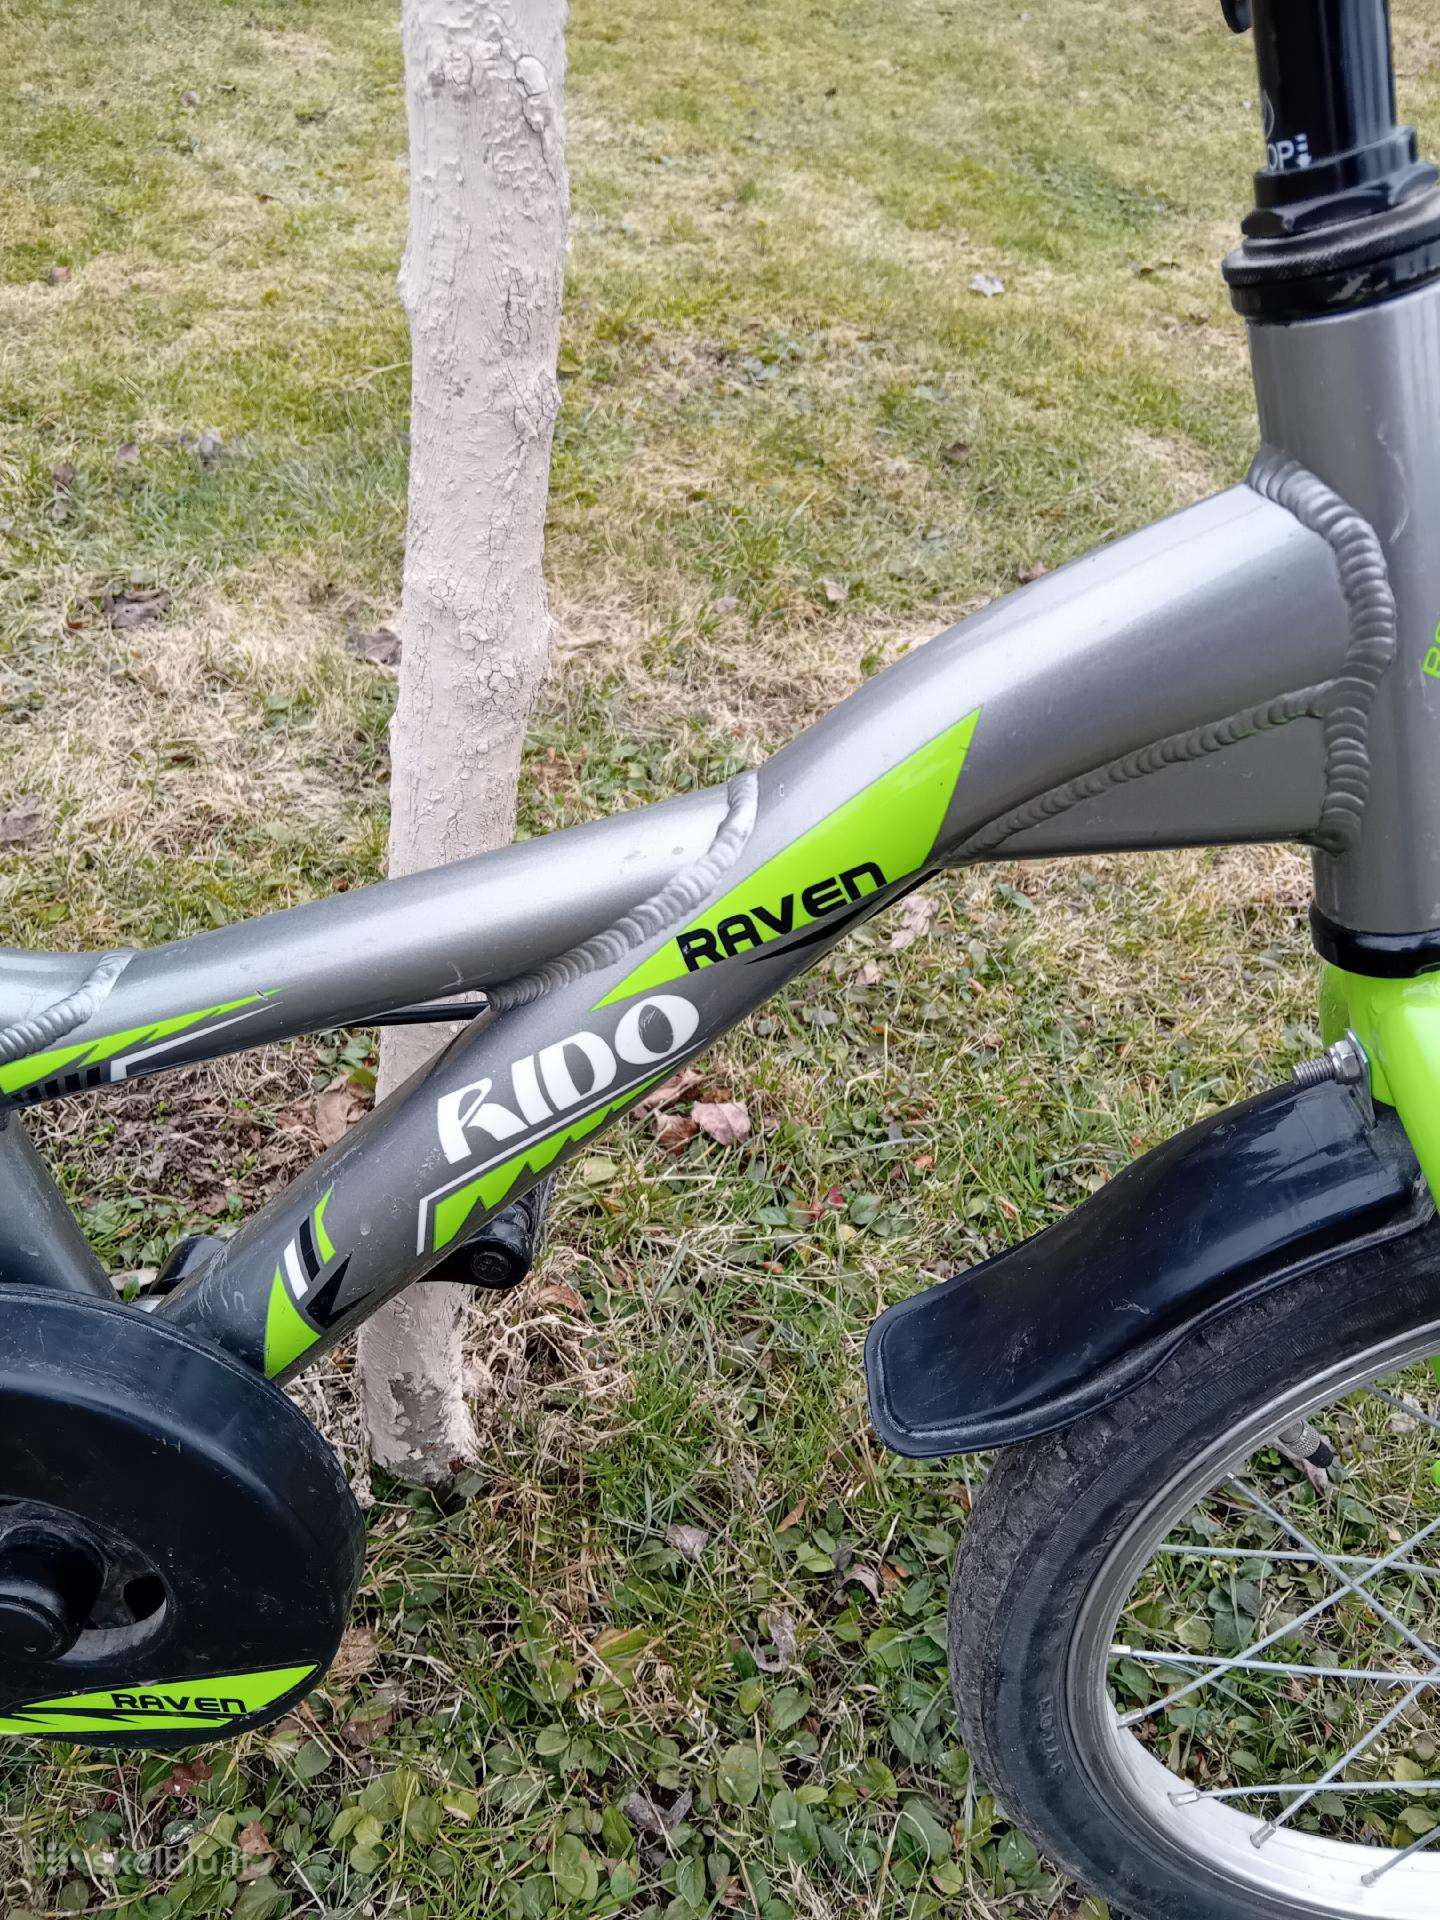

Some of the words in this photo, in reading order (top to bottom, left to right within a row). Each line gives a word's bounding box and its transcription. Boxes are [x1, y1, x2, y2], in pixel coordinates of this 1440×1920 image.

[676, 861, 888, 972] RAVEN
[436, 994, 700, 1164] RIDO
[111, 1693, 248, 1714] RAVEN
